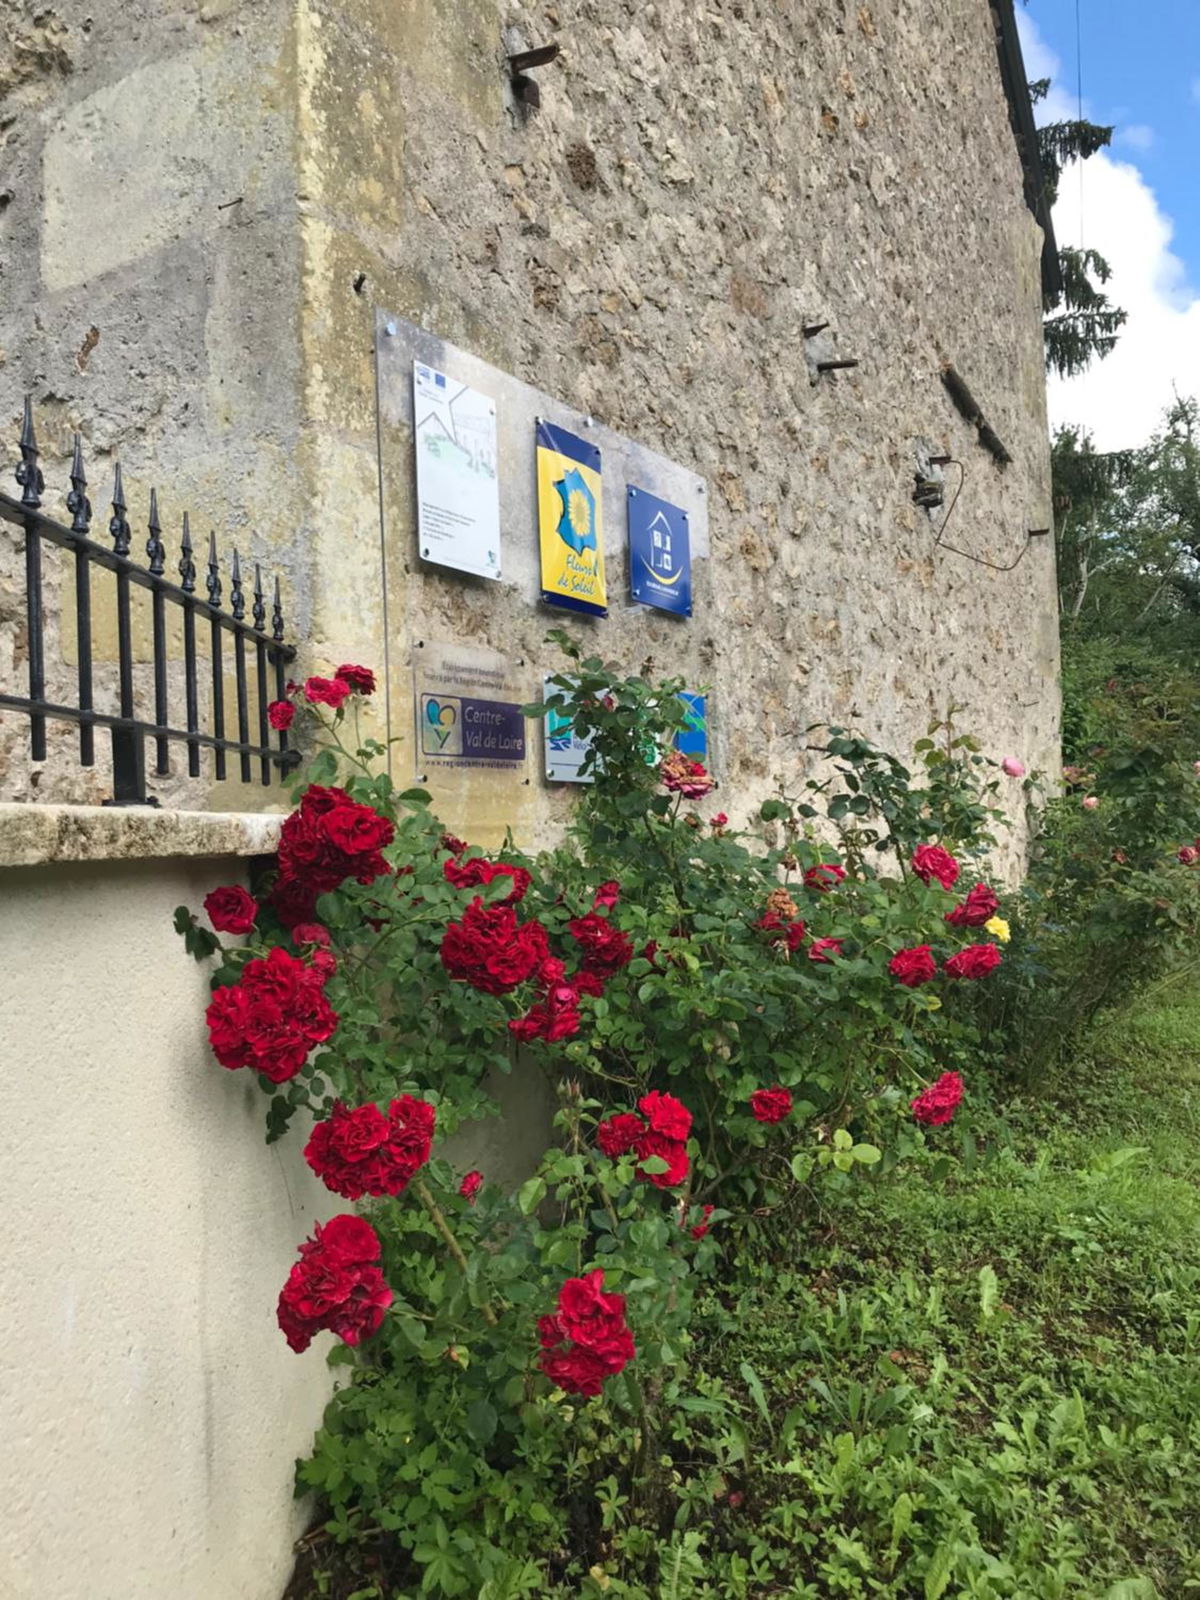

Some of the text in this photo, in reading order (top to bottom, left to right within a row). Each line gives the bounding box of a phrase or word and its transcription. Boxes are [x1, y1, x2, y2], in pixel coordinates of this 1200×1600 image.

[557, 572, 594, 595] de Soleil
[464, 706, 505, 726] Centre-
[465, 730, 523, 750] Val de Loire
